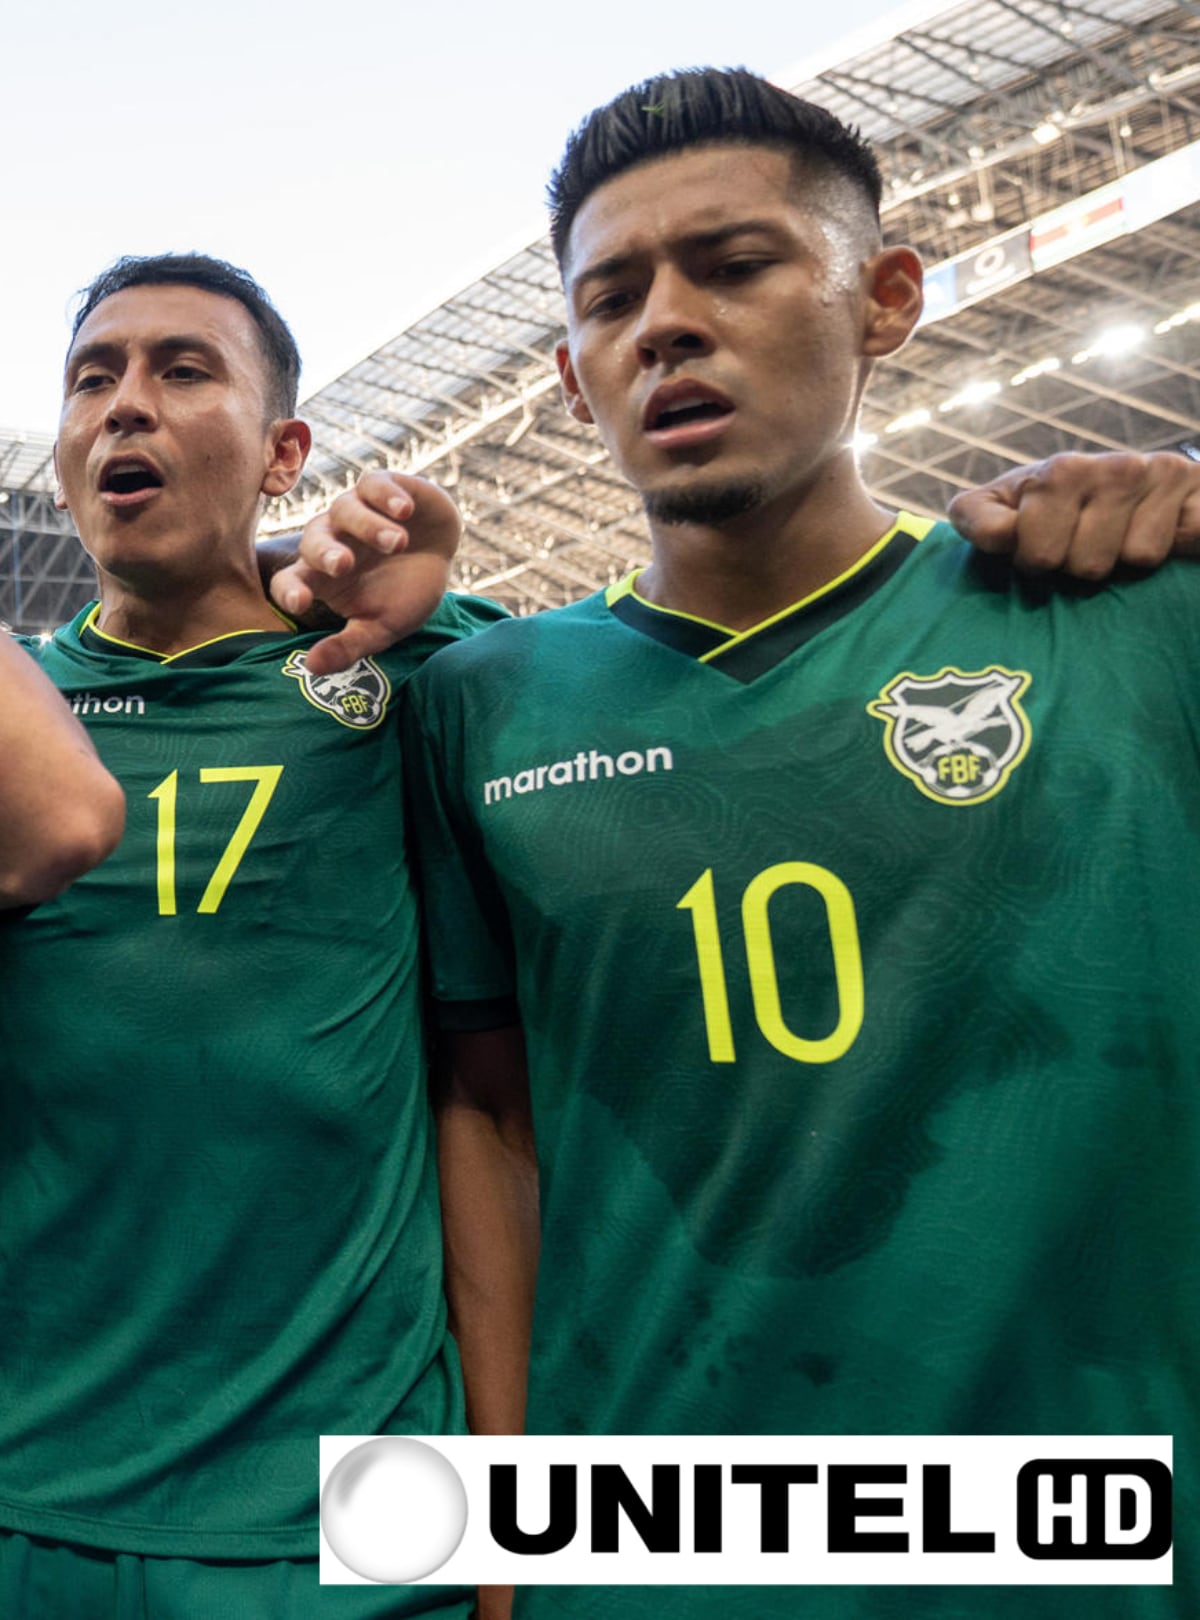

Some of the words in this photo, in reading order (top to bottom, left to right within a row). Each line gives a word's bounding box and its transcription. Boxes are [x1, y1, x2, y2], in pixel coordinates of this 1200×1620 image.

[68, 692, 145, 715] thon
[484, 746, 673, 805] marathon
[936, 754, 984, 784] FBF
[147, 765, 285, 916] 17
[676, 861, 865, 1064] 10
